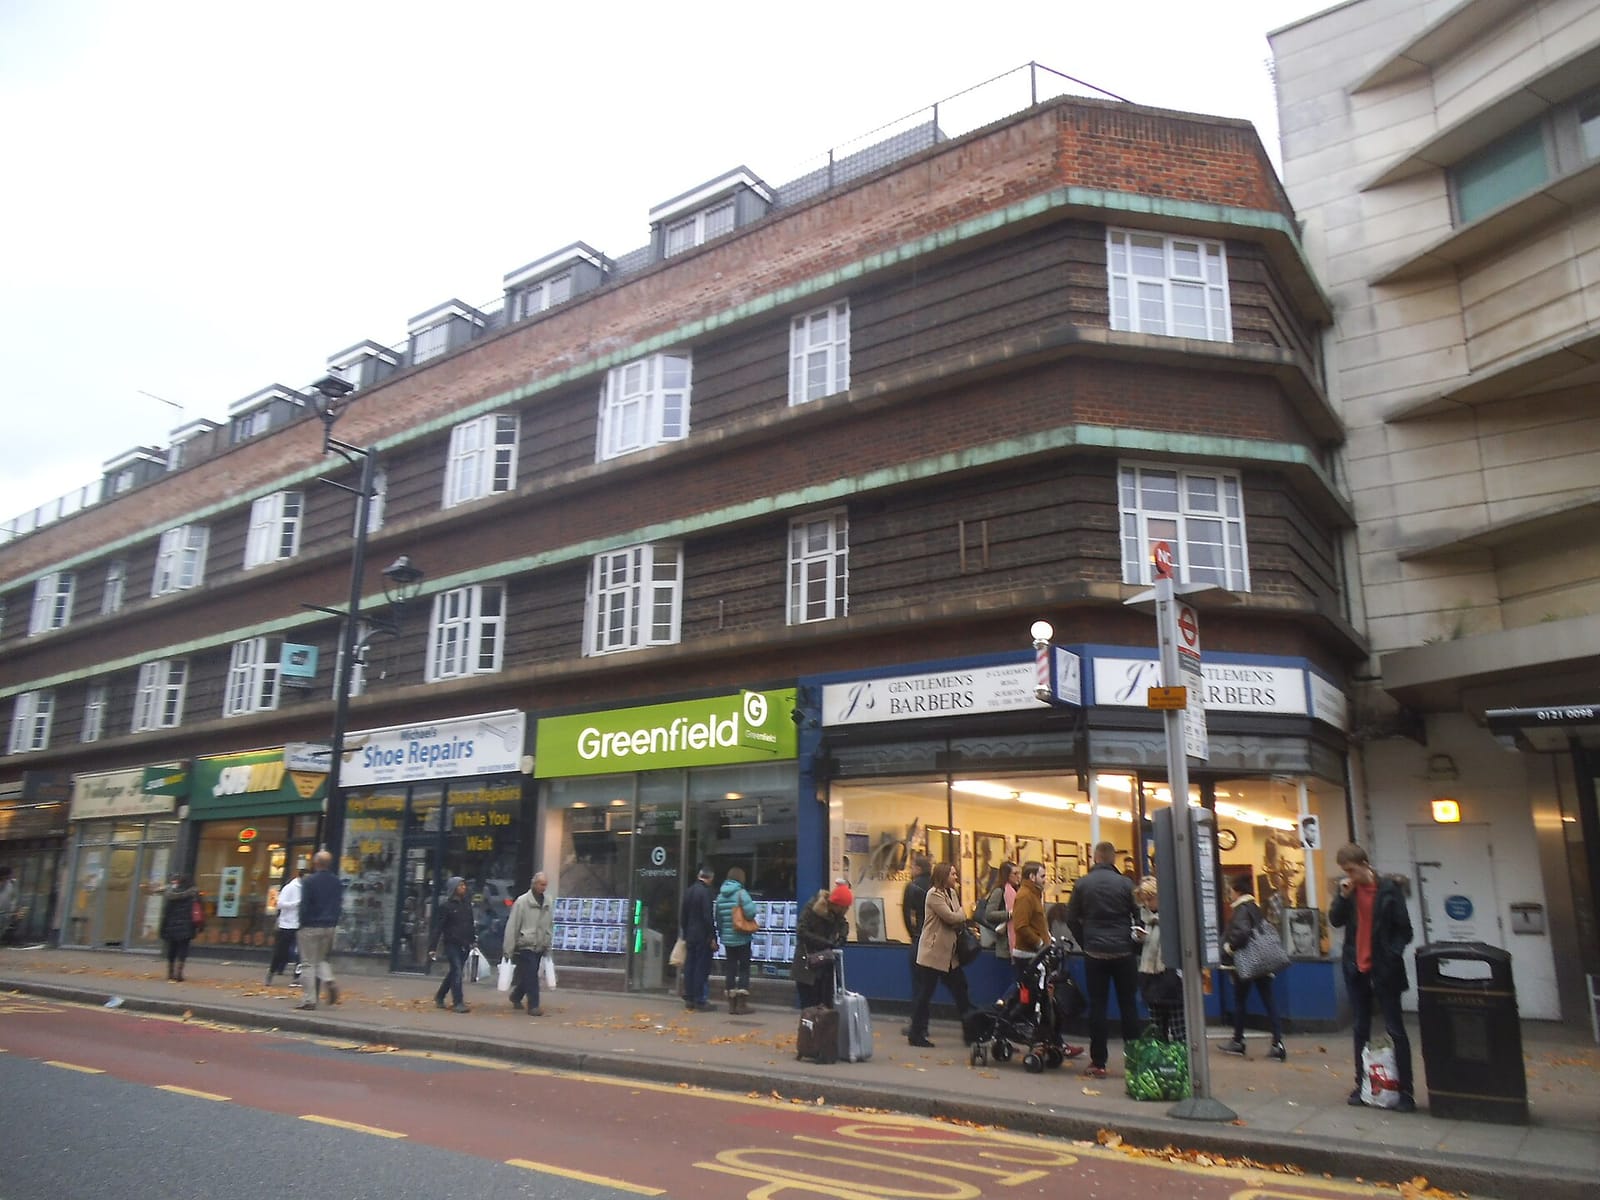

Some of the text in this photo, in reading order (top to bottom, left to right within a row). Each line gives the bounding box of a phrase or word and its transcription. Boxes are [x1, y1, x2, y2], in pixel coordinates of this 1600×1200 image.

[888, 674, 974, 694] GENTLEMEN'S
[1115, 662, 1161, 704] J'
[890, 691, 975, 715] BARBERS
[1200, 684, 1276, 706] RBERS
[578, 712, 738, 760] Greenfield
[363, 745, 405, 768] Shoe
[408, 736, 473, 768] Repairs
[454, 810, 487, 828] While
[488, 809, 511, 827] You
[467, 834, 493, 851] Wait
